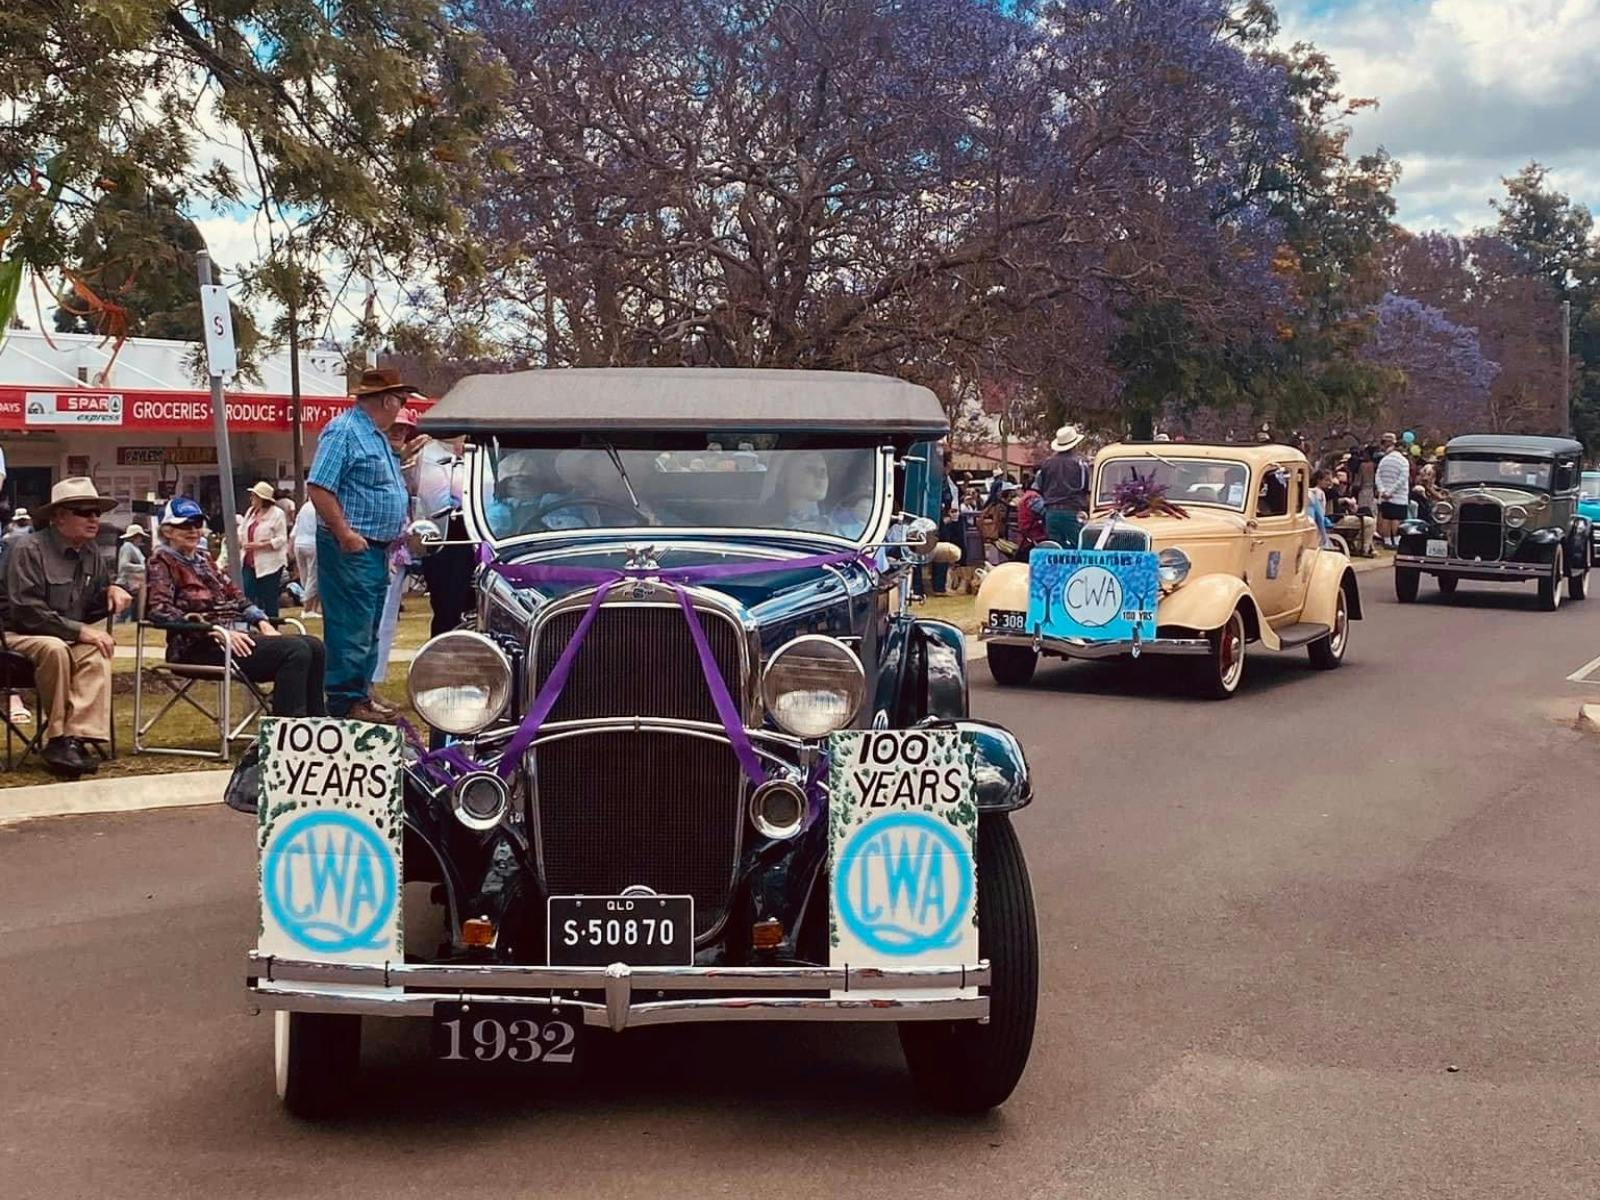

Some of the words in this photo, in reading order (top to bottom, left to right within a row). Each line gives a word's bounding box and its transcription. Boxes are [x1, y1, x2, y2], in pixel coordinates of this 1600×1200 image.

[213, 315, 225, 337] S
[67, 397, 109, 410] SPAR
[132, 401, 208, 420] GROCERIES
[225, 403, 276, 421] RODUCE
[76, 414, 120, 423] express
[1066, 575, 1117, 609] CWA
[1122, 611, 1136, 621] 100
[1138, 611, 1153, 621] YRS
[276, 722, 344, 754] 100
[858, 733, 929, 765] 100
[285, 759, 387, 799] YEARS
[853, 768, 962, 808] YEARS
[606, 900, 635, 911] QLD
[438, 1018, 577, 1063] 1932
